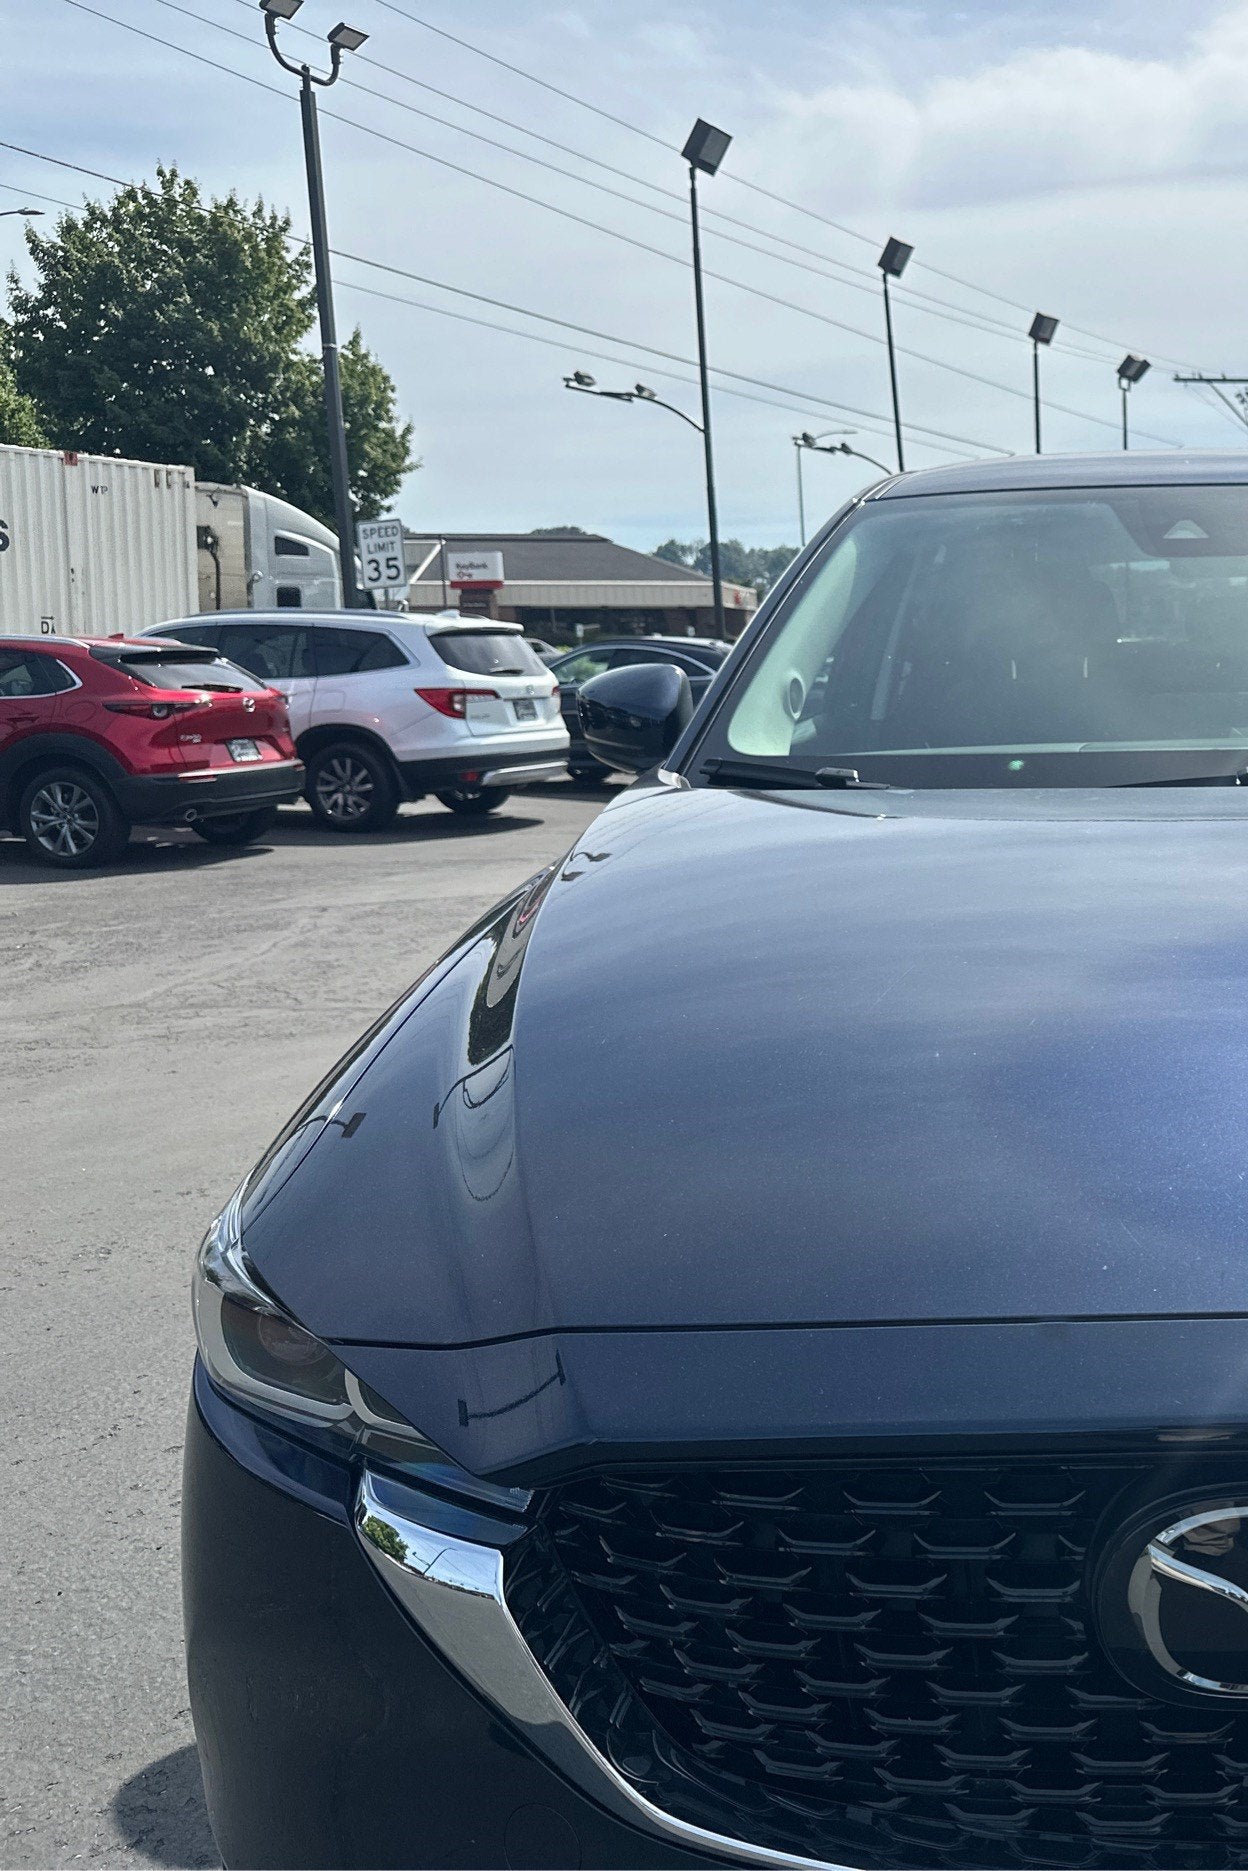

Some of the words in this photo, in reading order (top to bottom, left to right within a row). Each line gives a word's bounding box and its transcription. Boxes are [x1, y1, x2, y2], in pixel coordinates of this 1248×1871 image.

[362, 525, 399, 540] SPEED
[367, 541, 396, 554] LIMIT
[367, 556, 401, 582] 35
